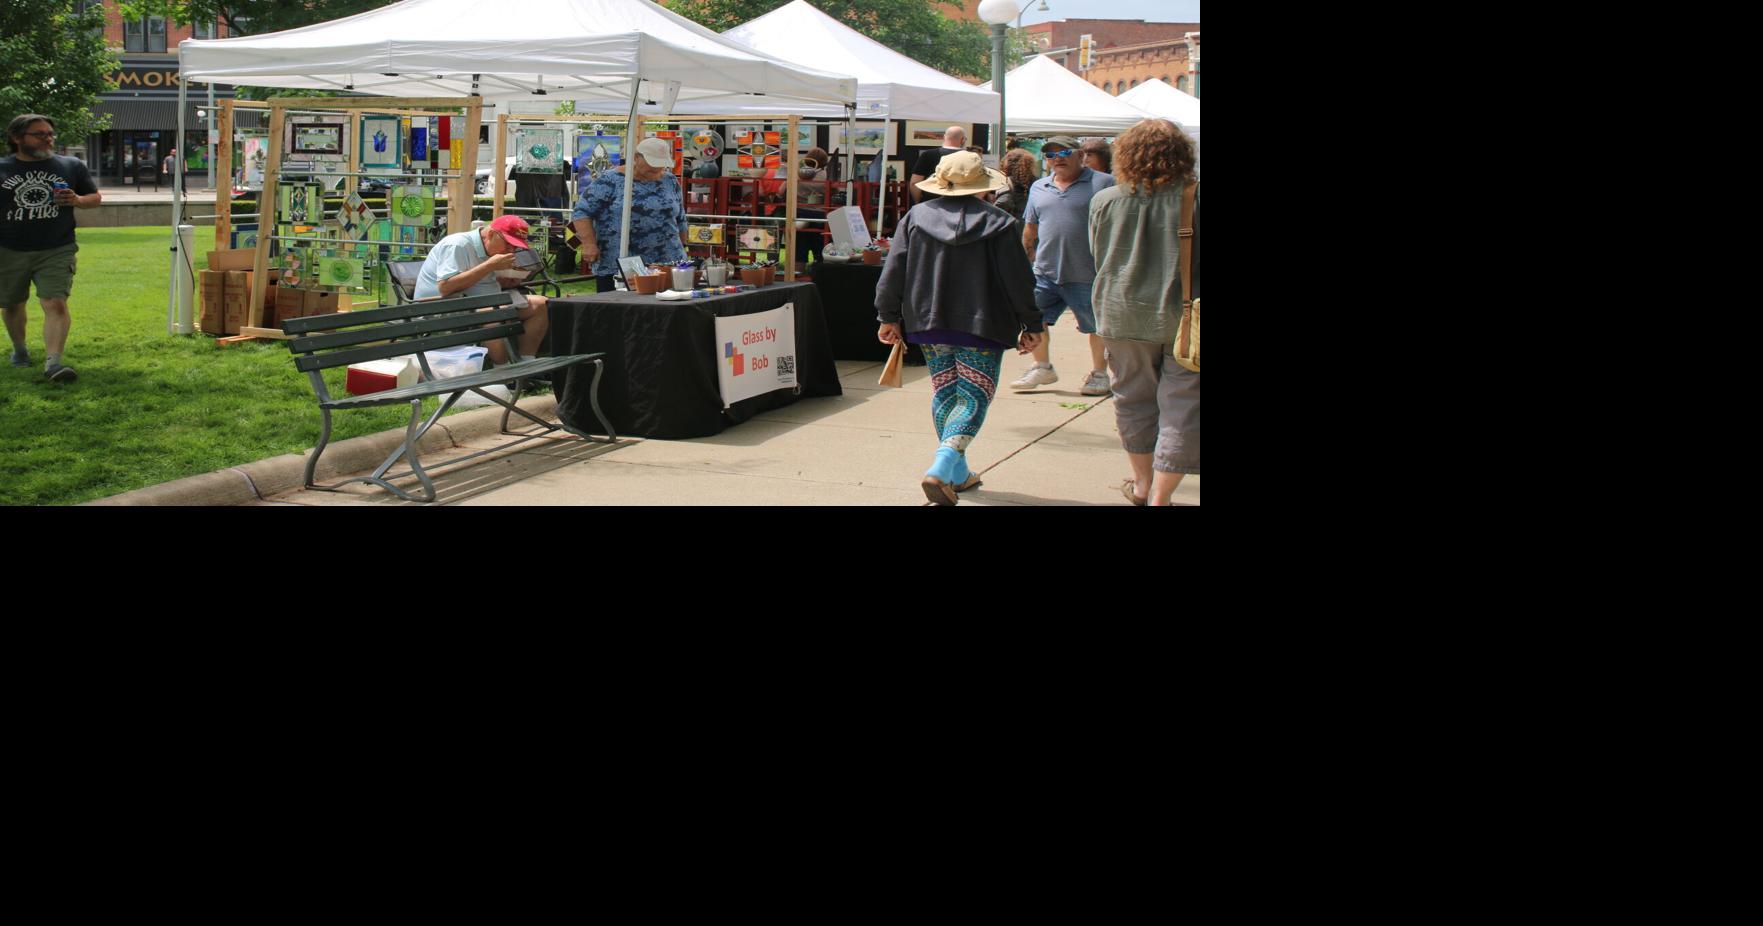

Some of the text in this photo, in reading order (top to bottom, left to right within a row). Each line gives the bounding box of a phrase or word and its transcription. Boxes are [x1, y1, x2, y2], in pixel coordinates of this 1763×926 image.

[742, 327, 777, 346] Glass by
[751, 354, 769, 372] Bob
